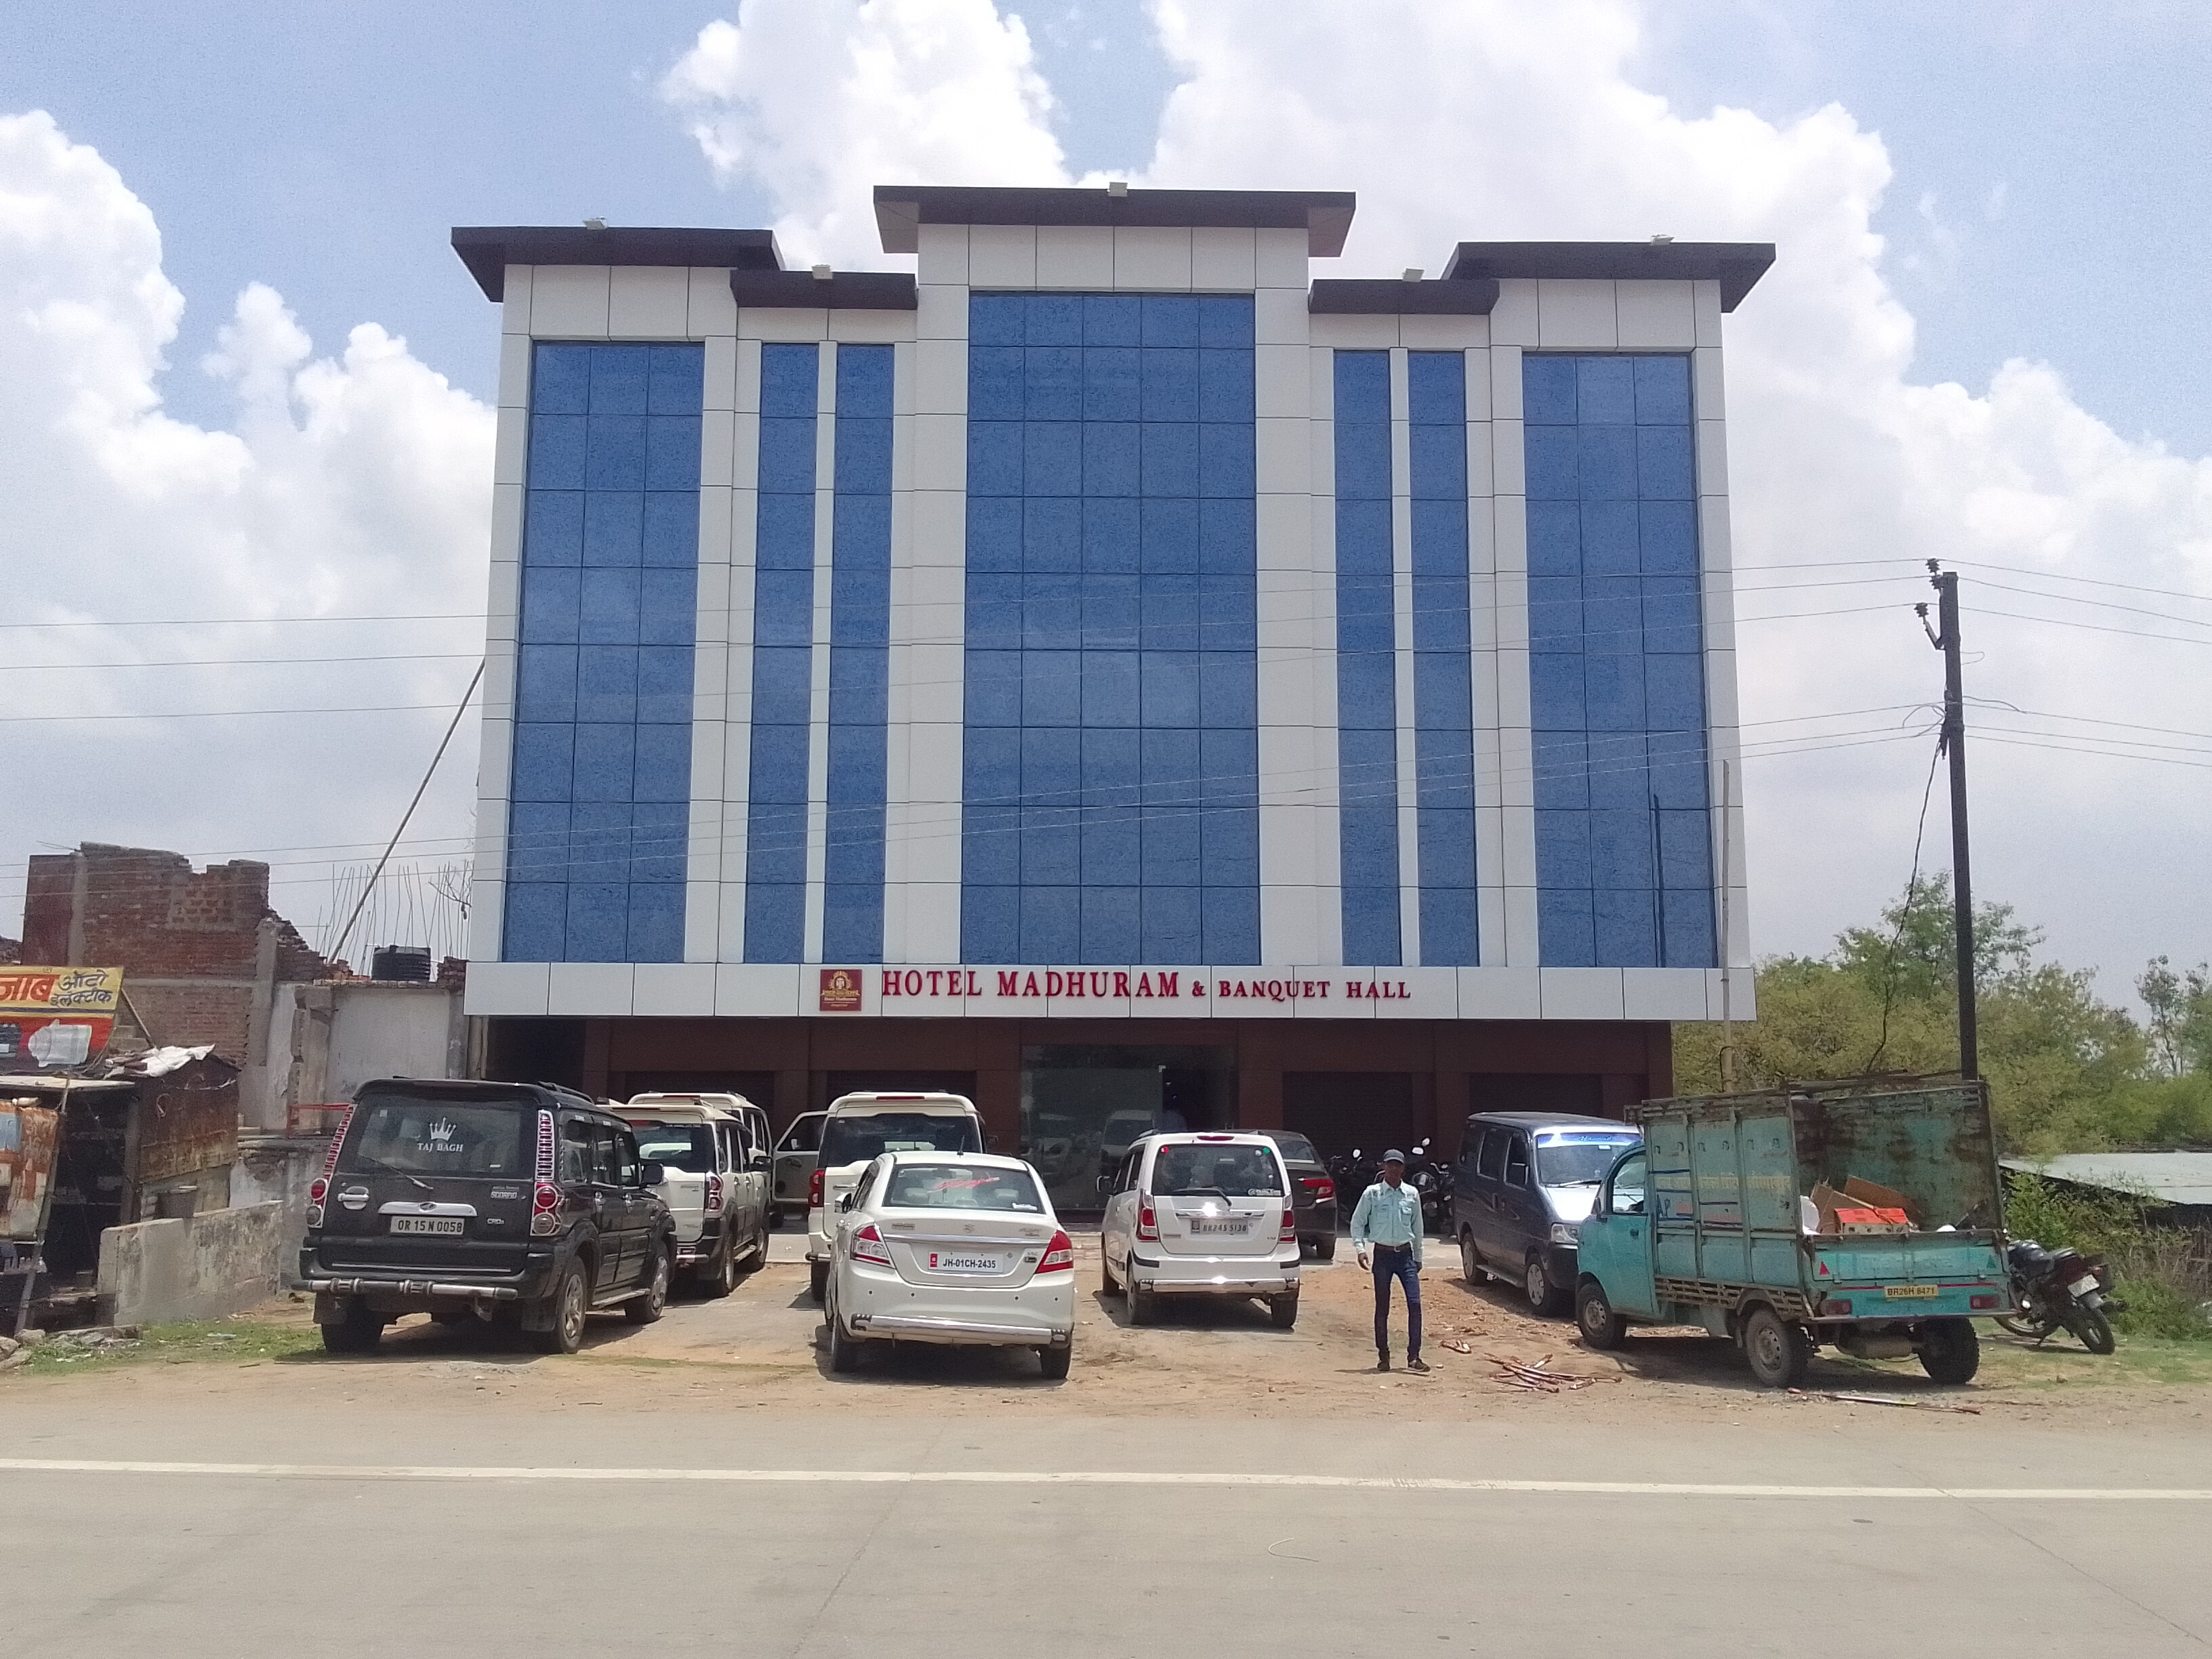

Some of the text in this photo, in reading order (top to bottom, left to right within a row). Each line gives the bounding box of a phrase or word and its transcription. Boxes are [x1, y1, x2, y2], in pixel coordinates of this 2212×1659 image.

[882, 970, 1411, 1002] HOTEL MADHURAM & BANQUET HALL
[417, 1143, 464, 1153] TAJ BAGH
[398, 1220, 463, 1233] OR 15 N 0058
[943, 1258, 996, 1269] JH-01CH-2435
[1887, 1286, 1934, 1296] BR26H 8471
